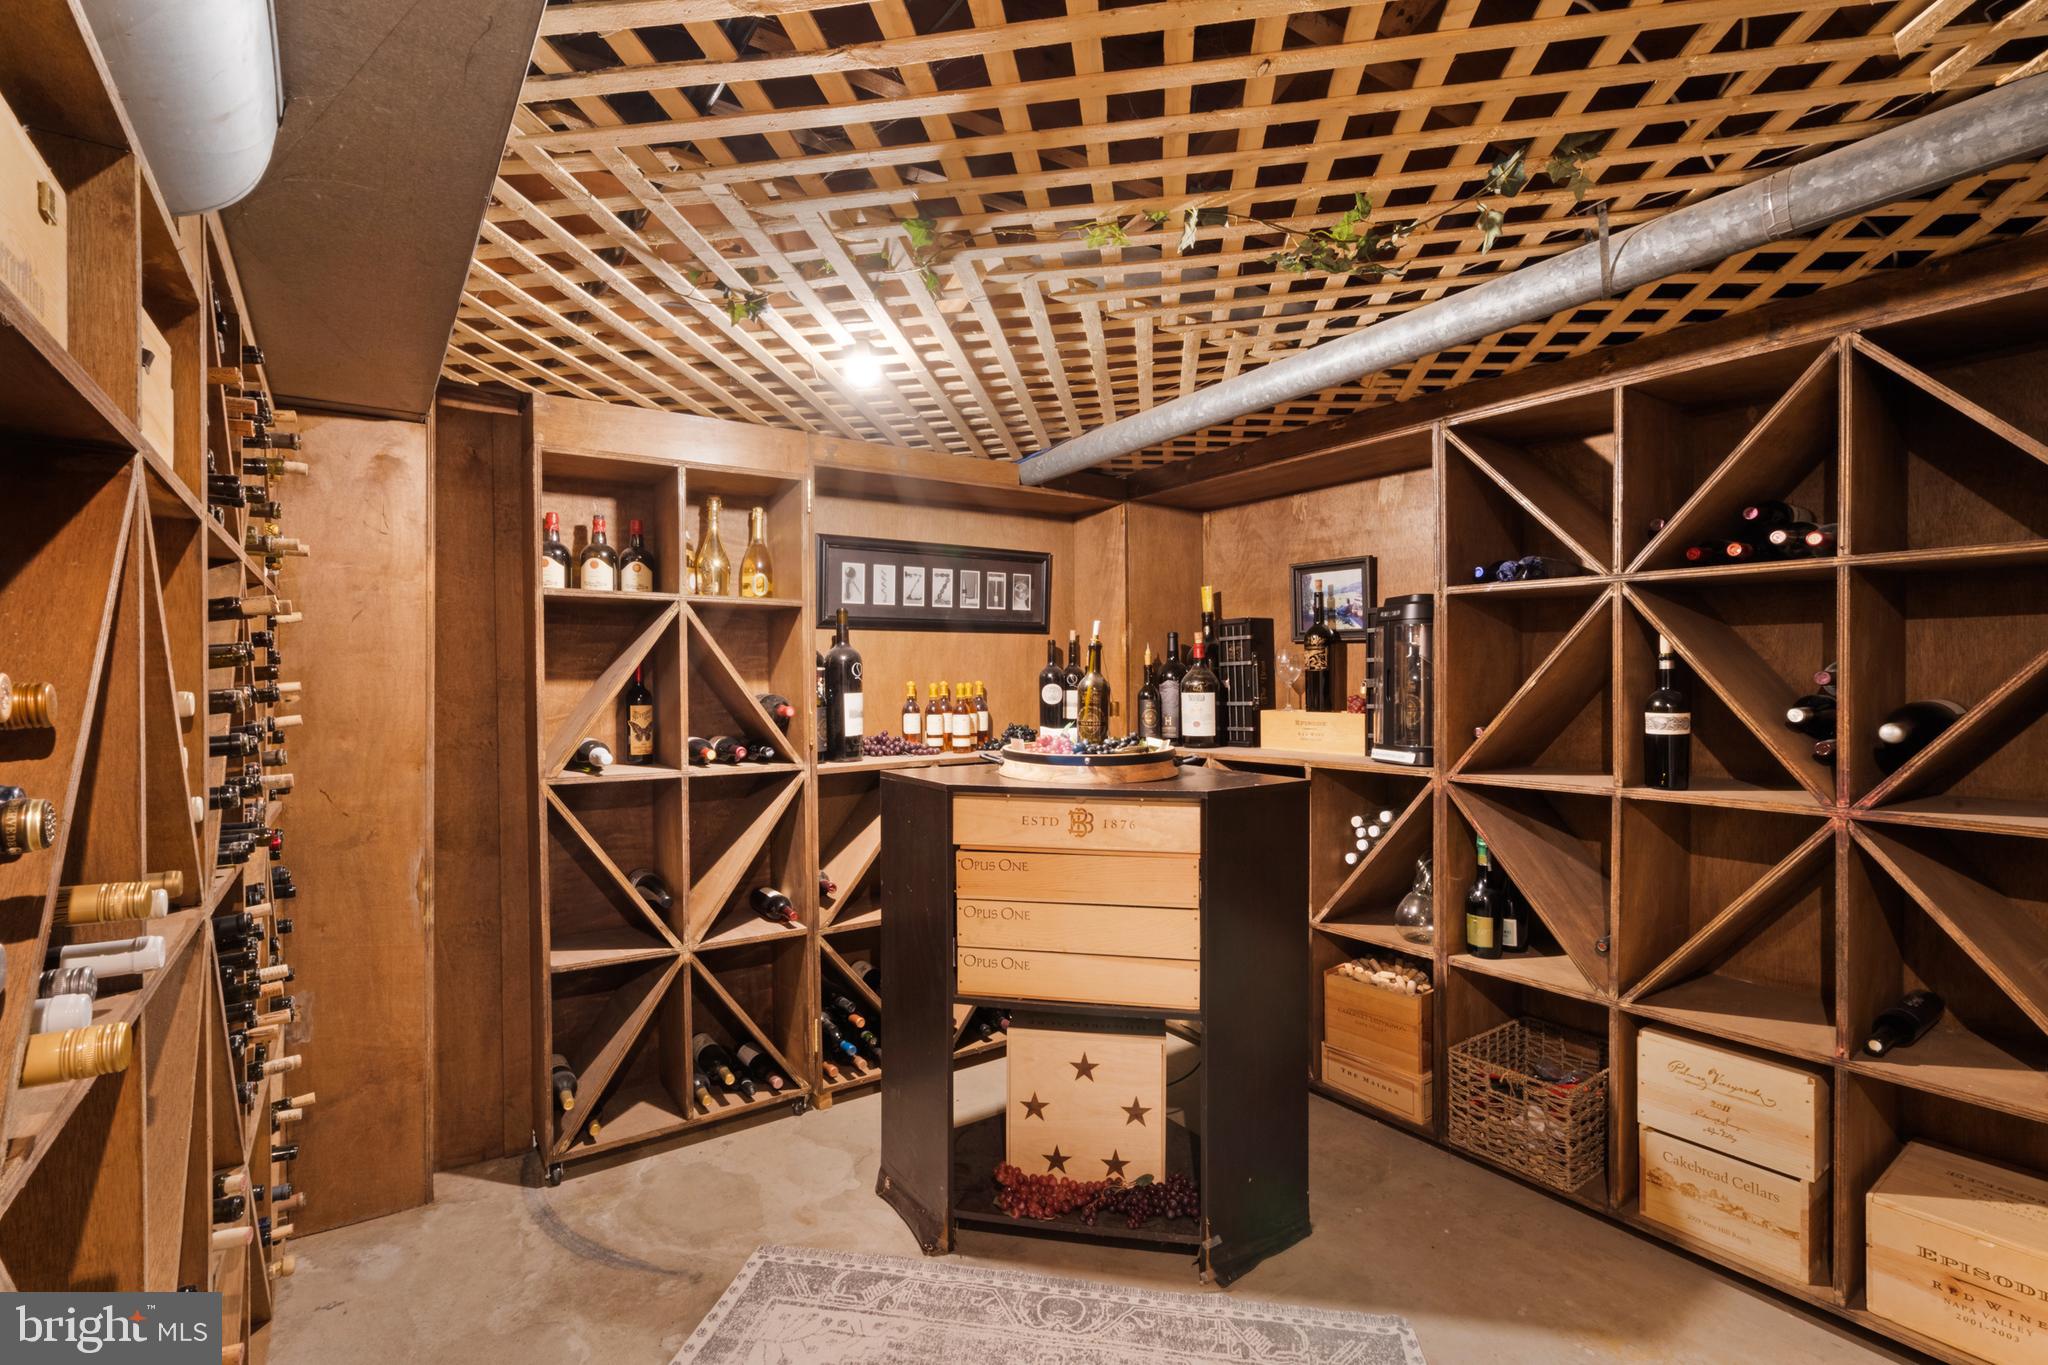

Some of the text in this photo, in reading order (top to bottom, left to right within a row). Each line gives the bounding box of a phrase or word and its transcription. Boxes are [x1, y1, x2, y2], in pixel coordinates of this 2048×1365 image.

[1021, 815, 1060, 827] ESTD
[1103, 819, 1136, 830] 1876
[1662, 1150, 1781, 1203] Cakebread Cellars
[1931, 1279, 2048, 1330] RED WINE
[1943, 1297, 2034, 1337] NAPA VALLEY
